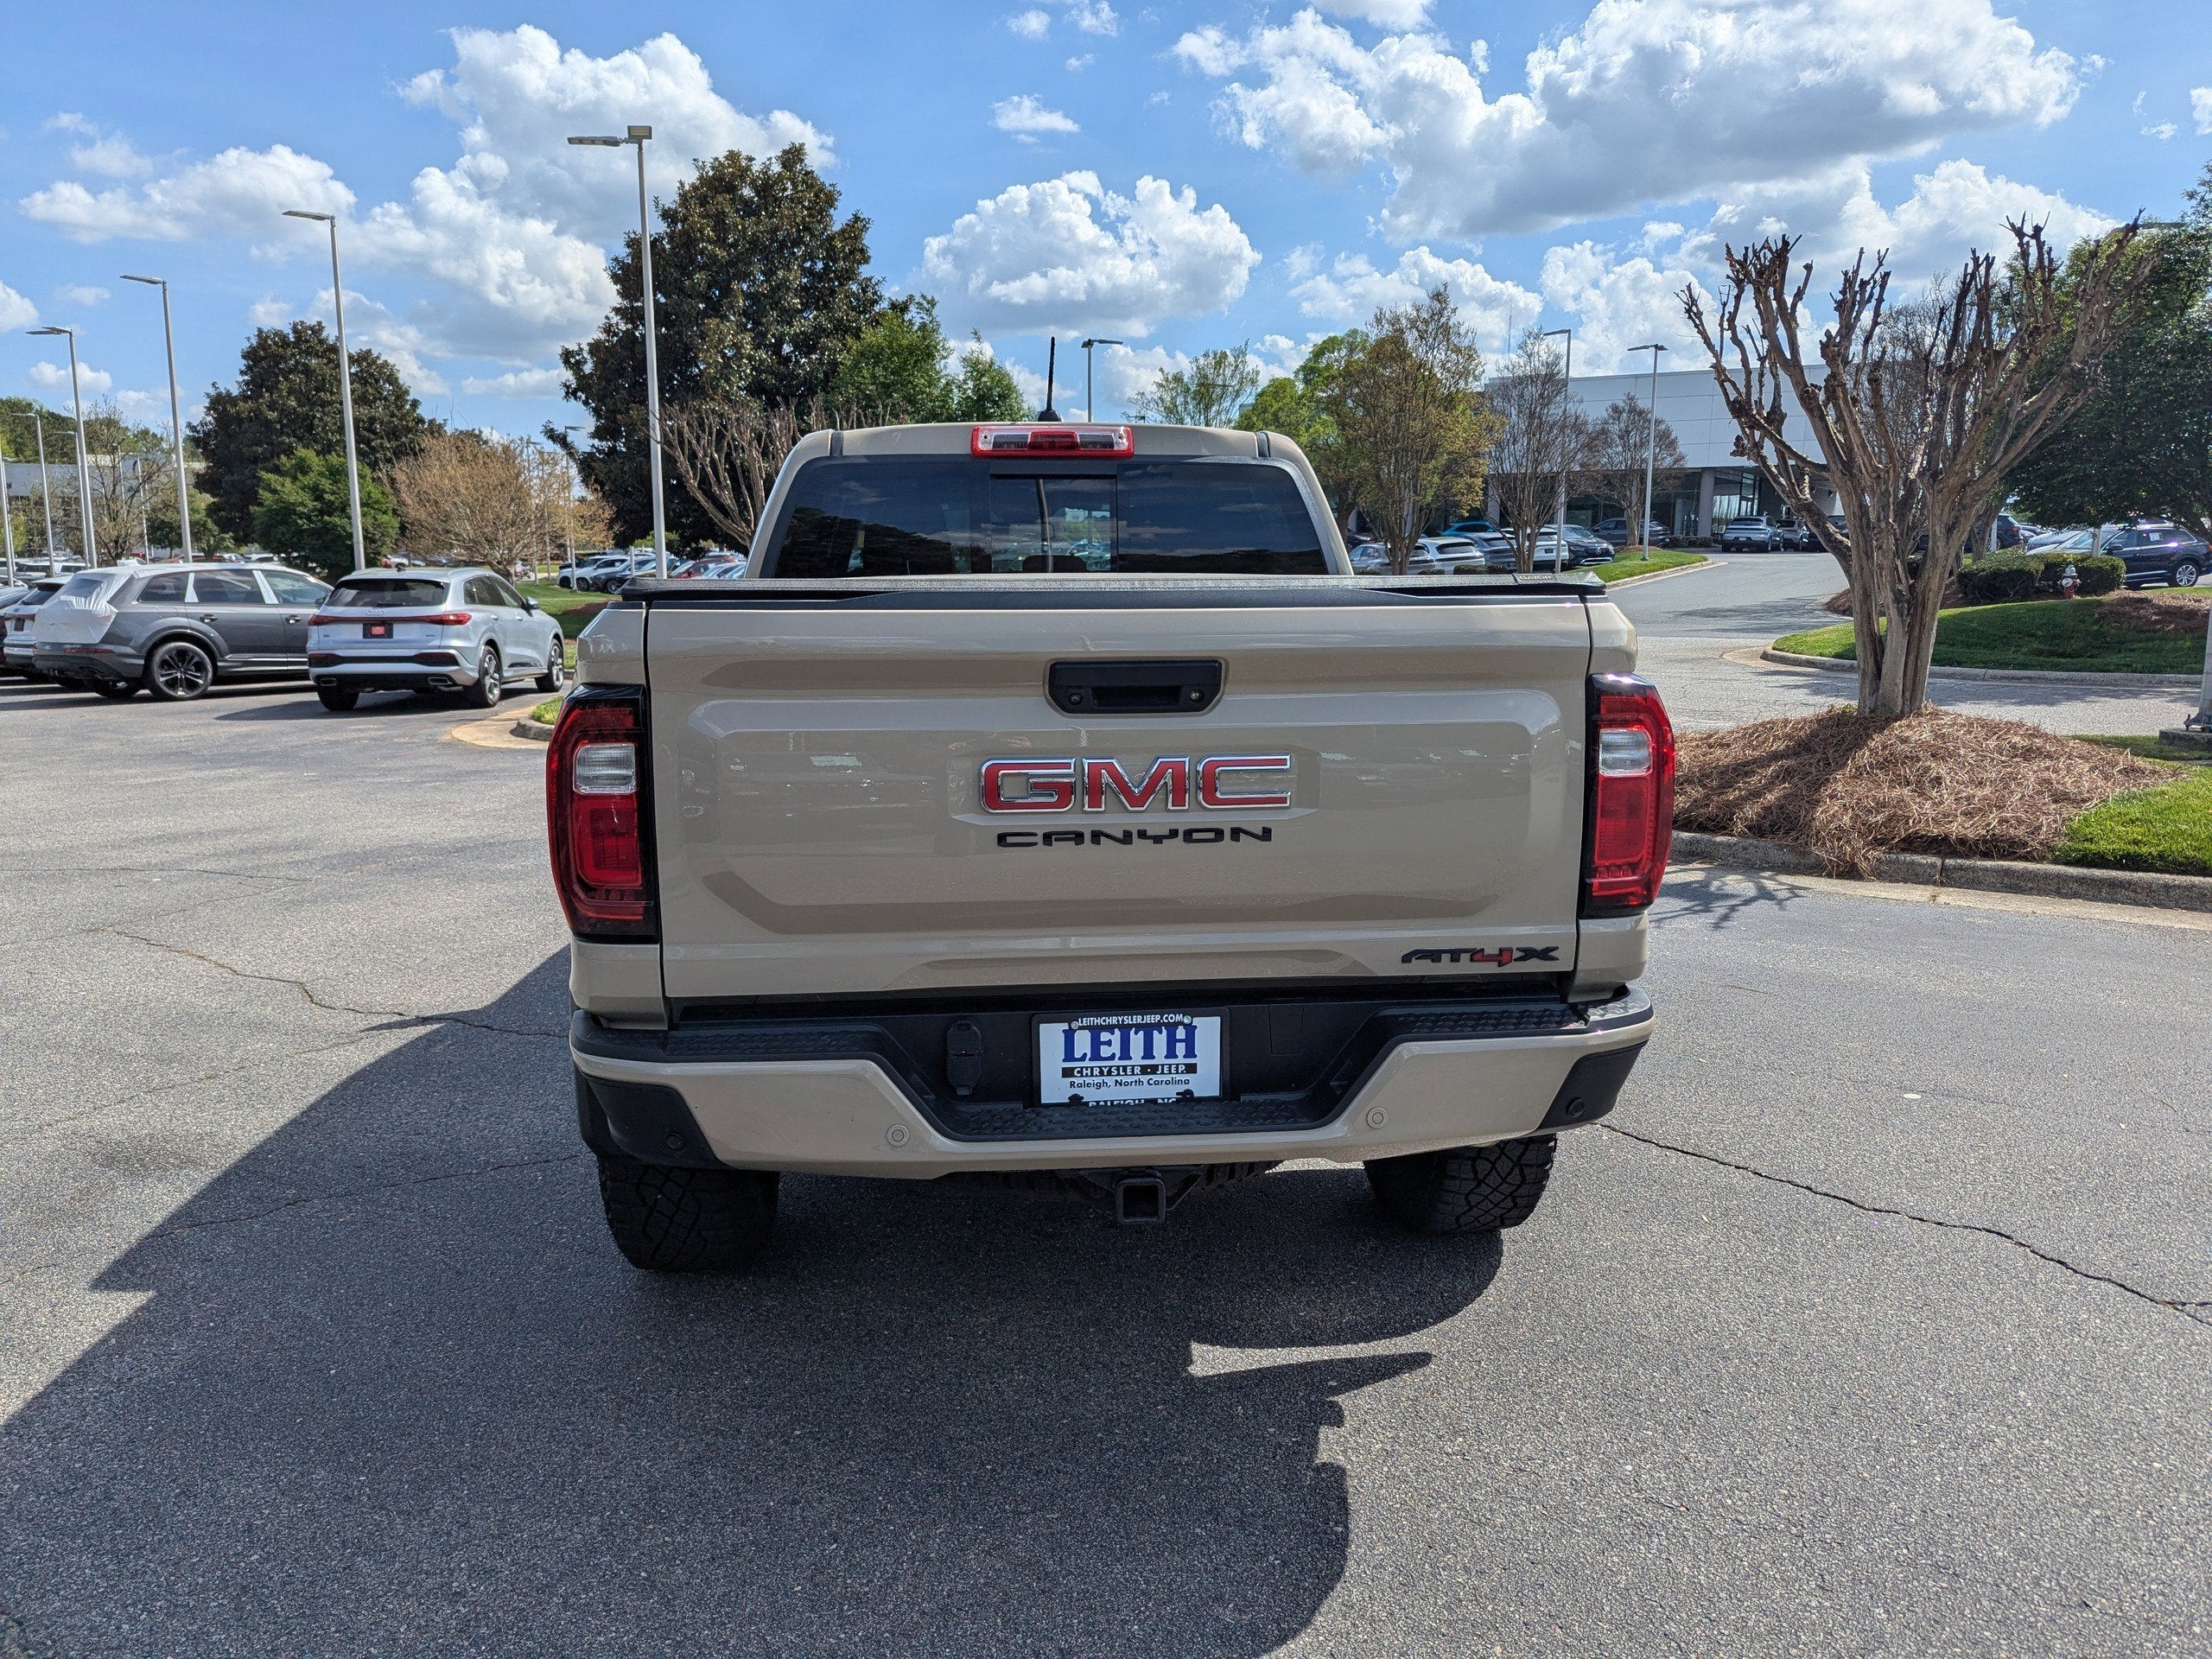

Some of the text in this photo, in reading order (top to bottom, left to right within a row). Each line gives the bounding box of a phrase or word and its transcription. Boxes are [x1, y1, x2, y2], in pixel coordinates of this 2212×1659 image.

[980, 753, 1292, 814] GMC
[997, 826, 1273, 848] CANYON
[1401, 946, 1560, 967] AT4X
[1078, 1014, 1184, 1027] LEITHCHRYSLERJEEP.COM
[1061, 1025, 1198, 1063] LEITH
[1073, 1066, 1142, 1077] CHRYSLER
[1069, 1076, 1191, 1090] Raleigh, North Carolina
